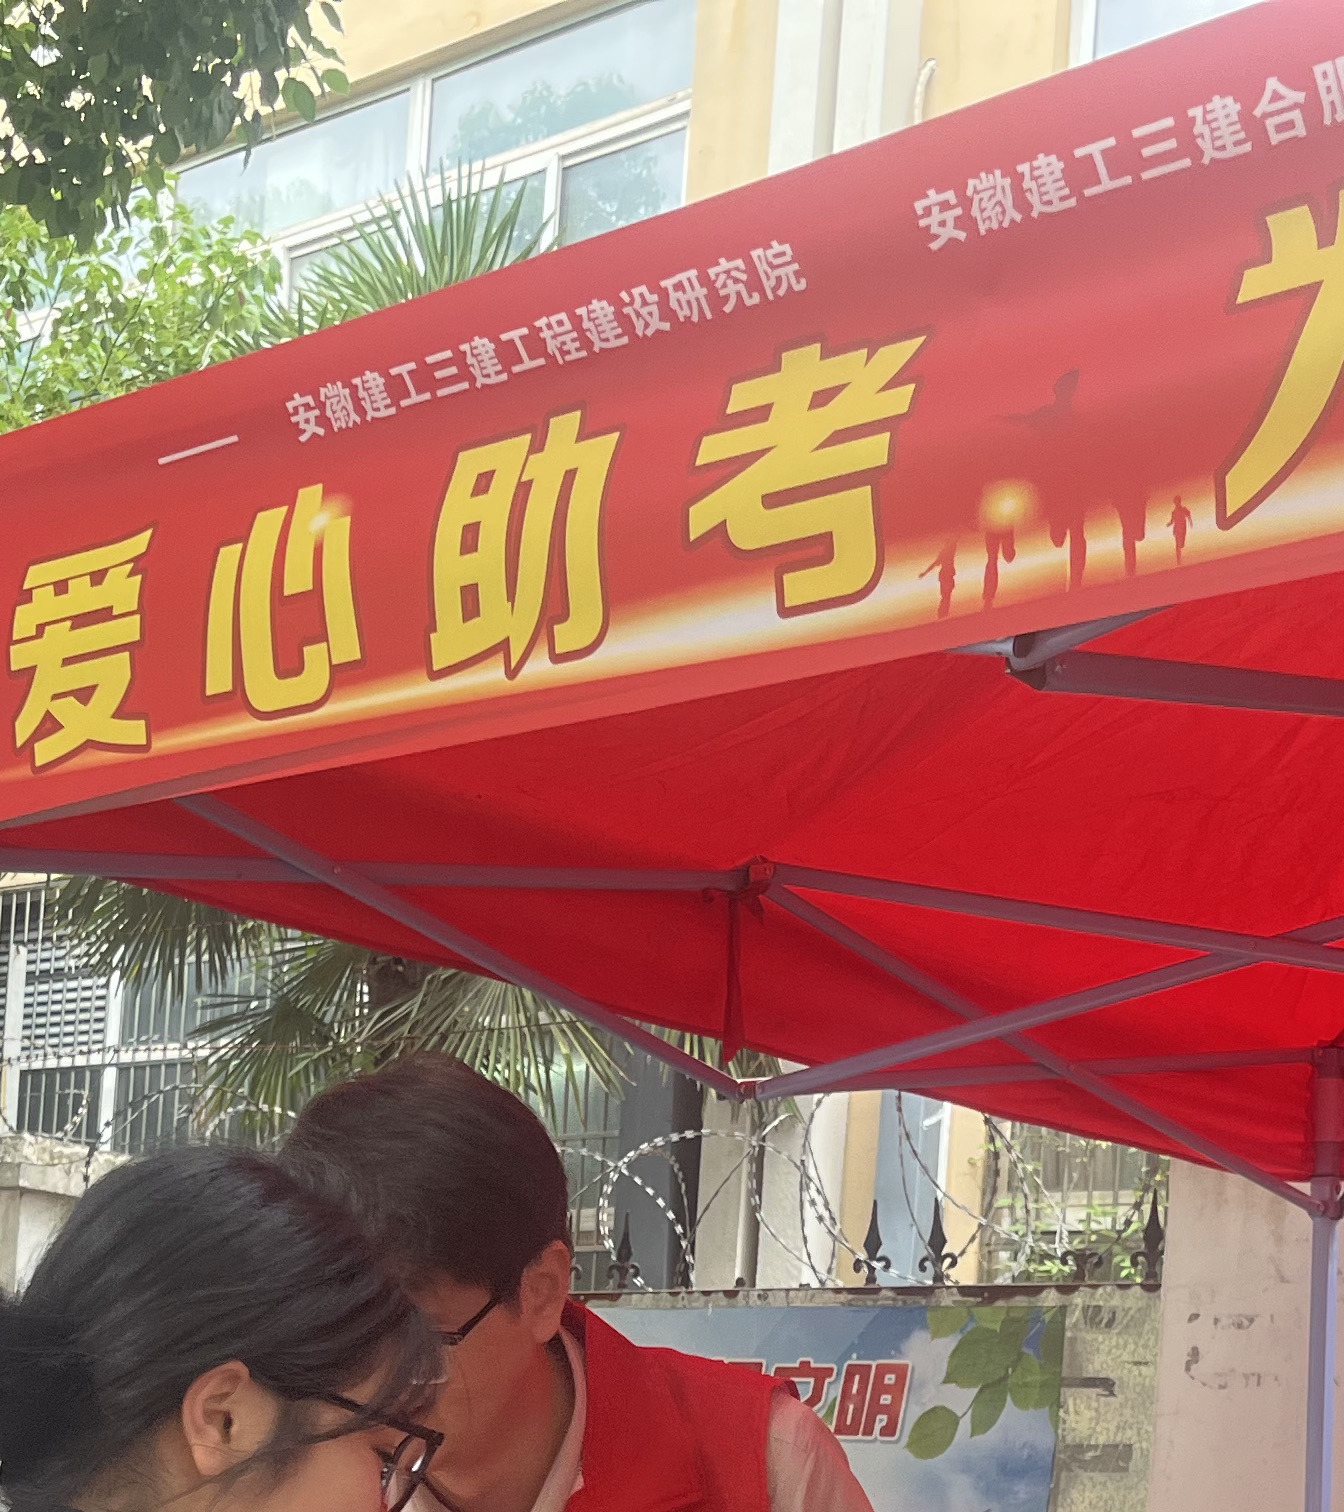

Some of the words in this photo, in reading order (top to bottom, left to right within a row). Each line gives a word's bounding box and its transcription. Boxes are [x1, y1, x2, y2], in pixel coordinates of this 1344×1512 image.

[285, 239, 808, 444] 安徽建工三建工程建设研究院
[8, 335, 929, 772] 爱心助考
[724, 1360, 910, 1437] 文明
